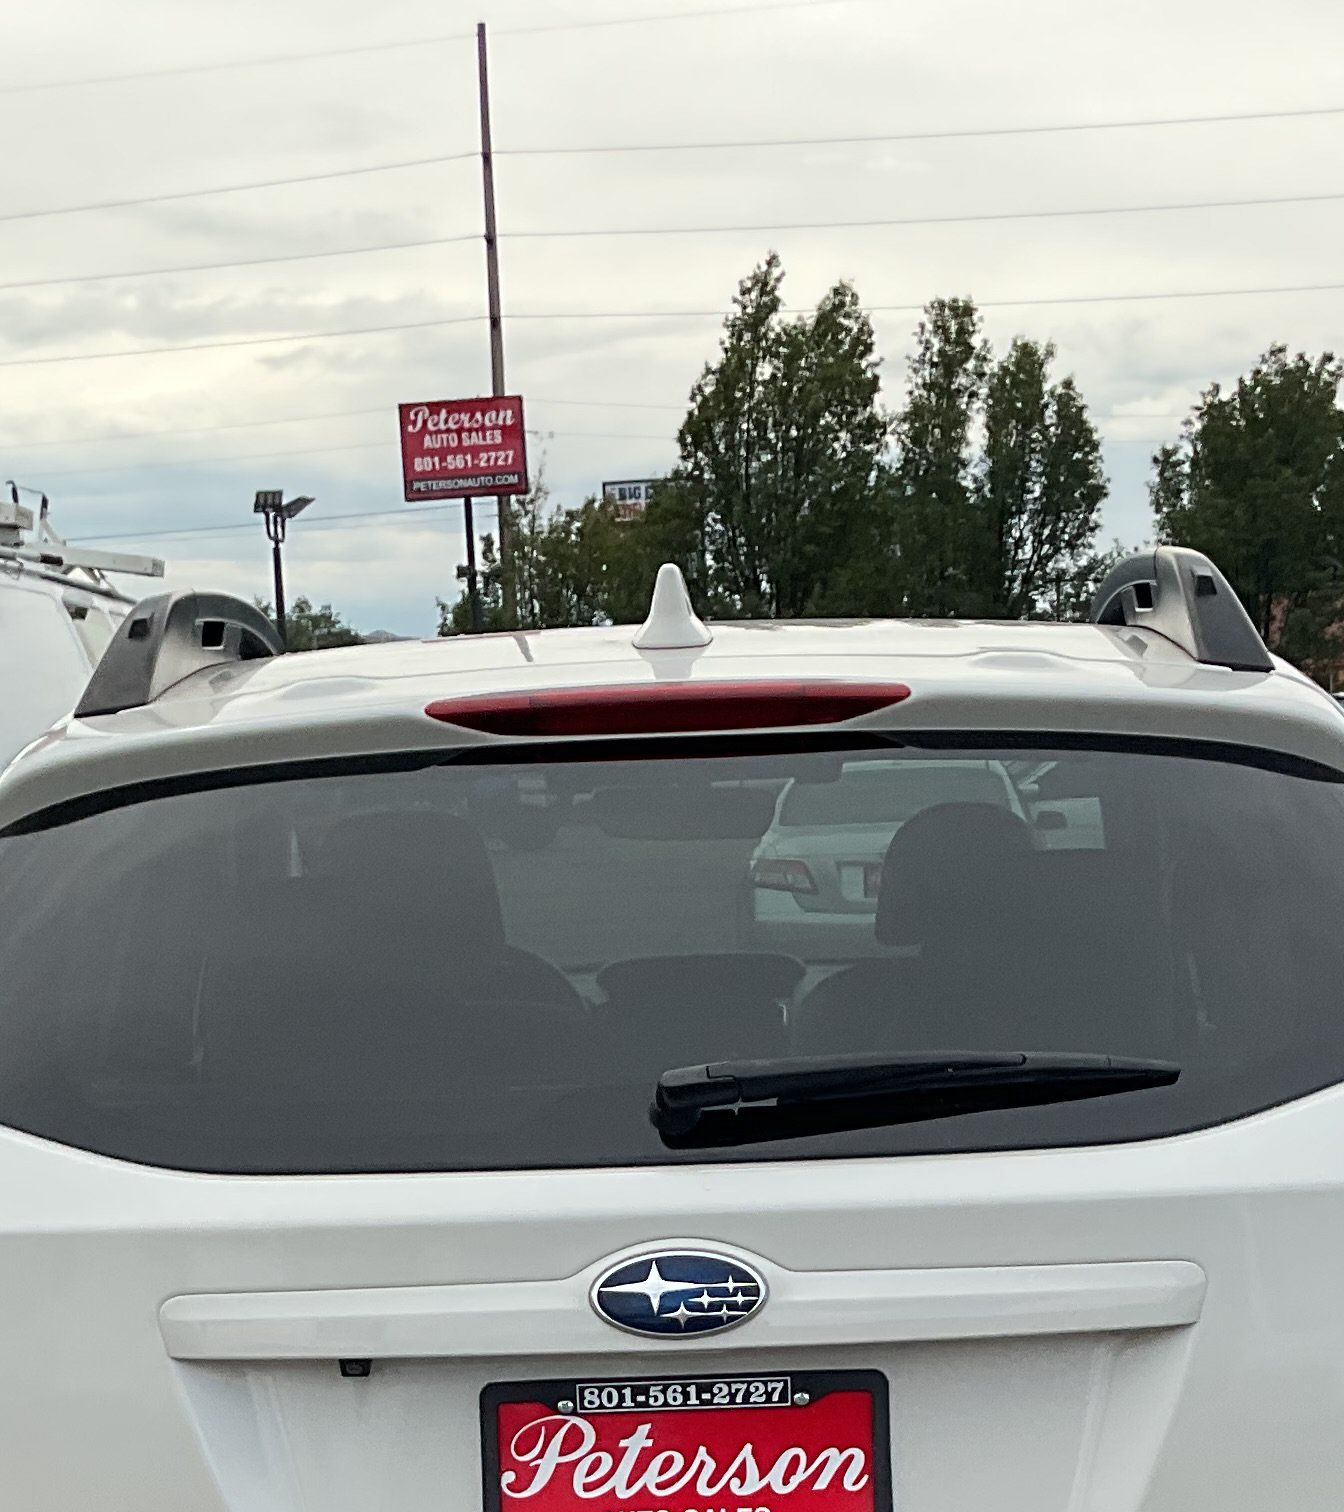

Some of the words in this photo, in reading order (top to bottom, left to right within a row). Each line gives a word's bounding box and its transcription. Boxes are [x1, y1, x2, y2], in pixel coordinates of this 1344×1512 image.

[408, 406, 515, 432] Peterson
[424, 433, 458, 449] AUTO
[462, 430, 502, 446] SALES
[414, 451, 514, 472] 801-561-2727
[413, 474, 519, 491] PETERSONAUTO.COM
[583, 1381, 785, 1408] 801-561-2727
[501, 1414, 869, 1499] Peterson
